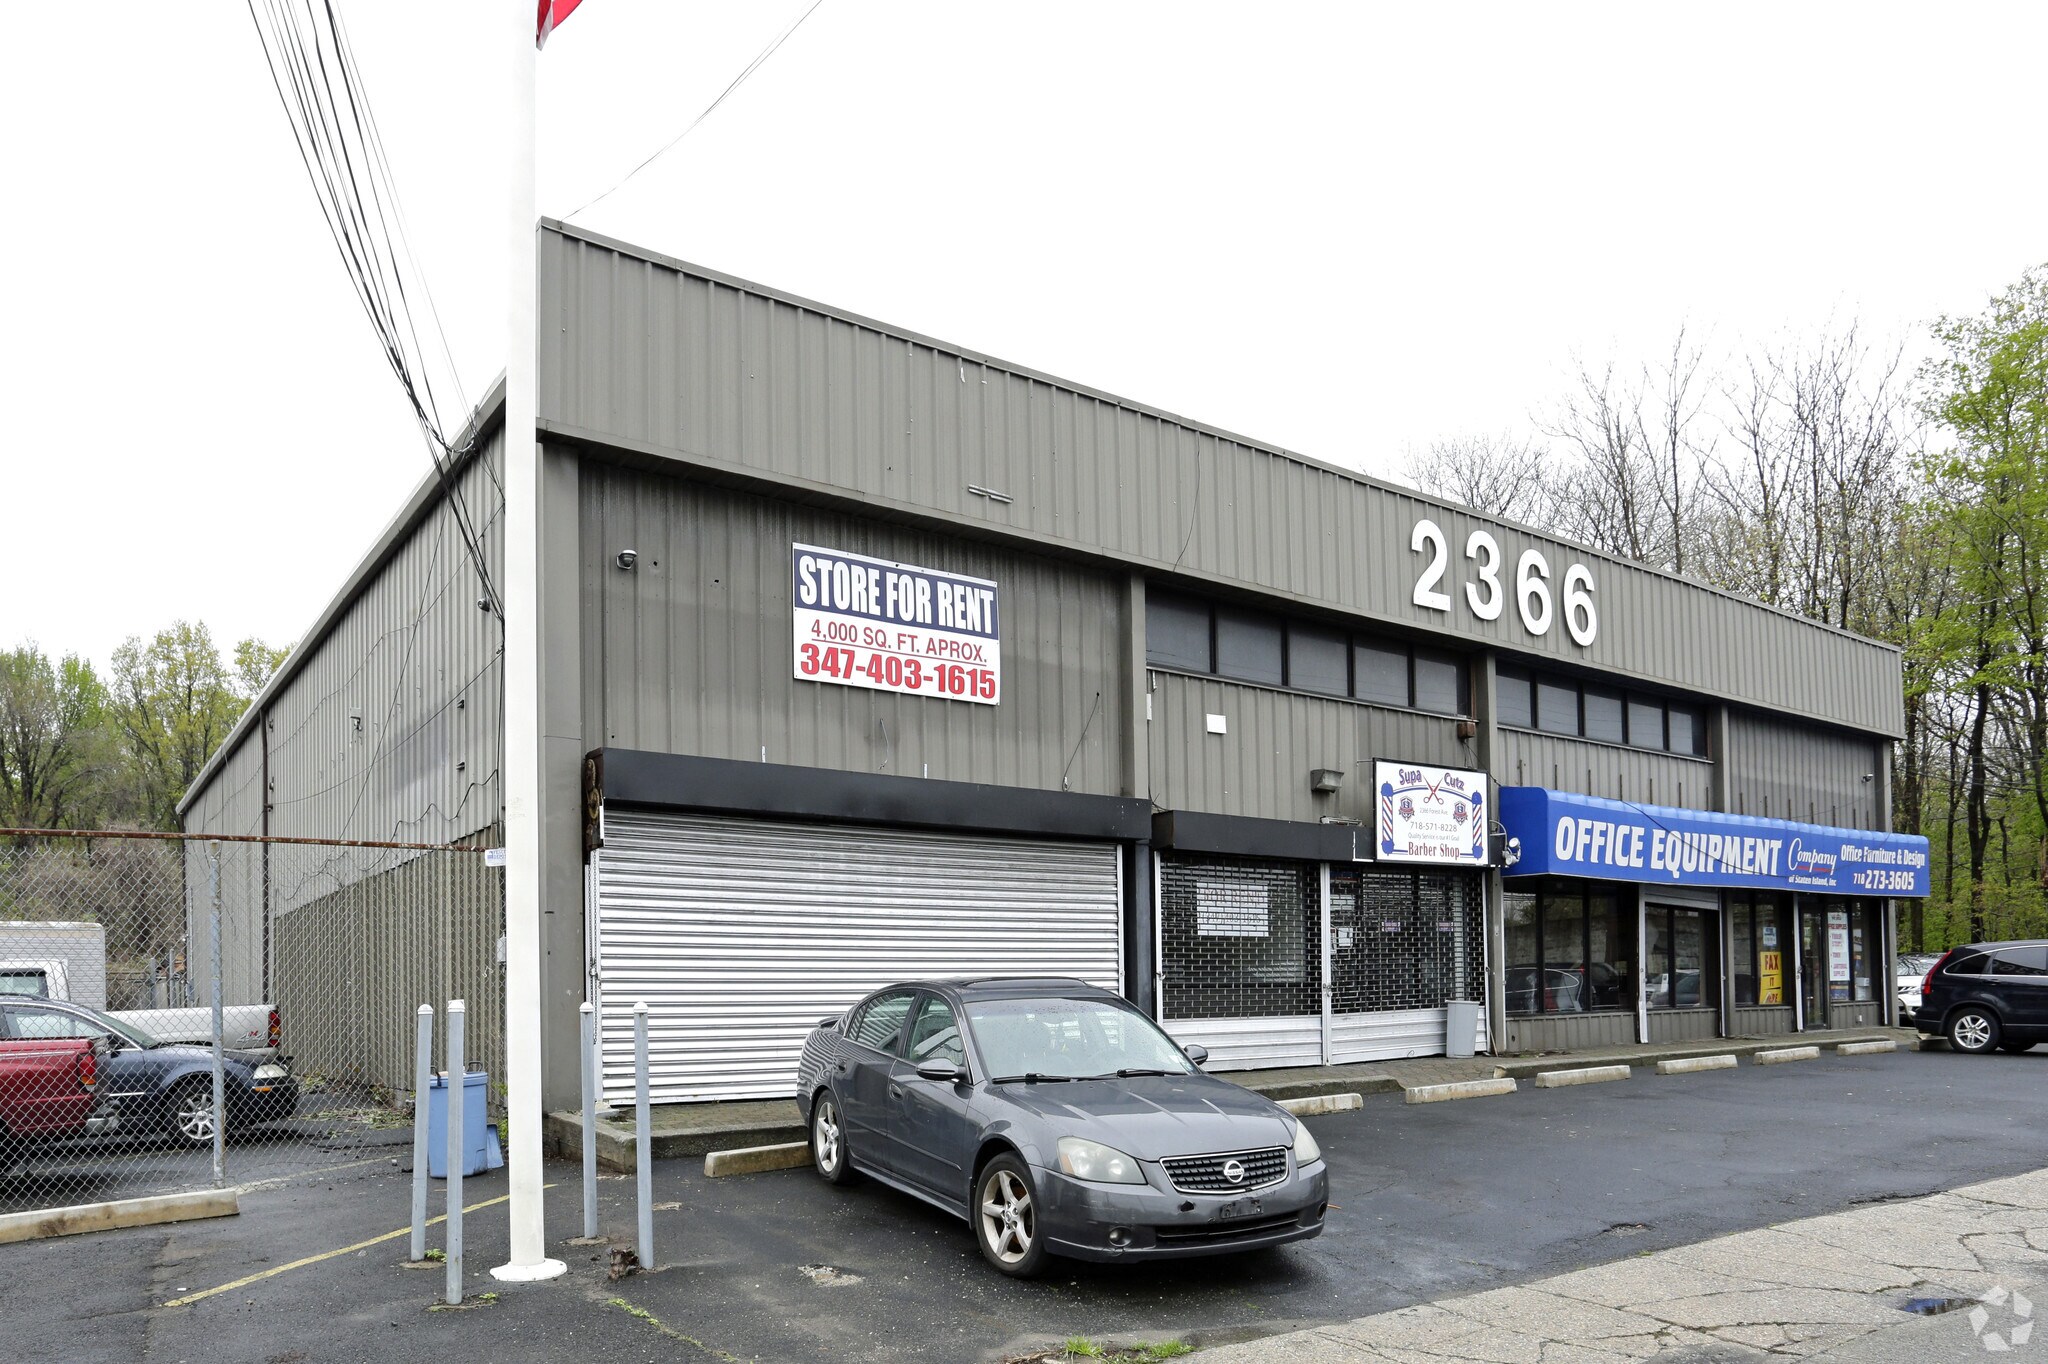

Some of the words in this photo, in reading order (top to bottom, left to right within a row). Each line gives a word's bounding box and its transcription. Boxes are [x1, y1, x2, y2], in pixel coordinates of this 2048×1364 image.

[799, 555, 881, 616] STORE
[886, 571, 932, 624] FOR
[937, 581, 994, 635] RENT
[1411, 519, 1598, 647] 2366
[811, 619, 857, 641] 4,000
[863, 626, 891, 649] SQ.
[897, 633, 920, 653] FT.
[926, 637, 987, 663] APROX.
[800, 643, 996, 699] 347-403-1615
[1398, 768, 1422, 786] Supa
[1443, 772, 1465, 791] Cutz
[1410, 821, 1458, 832] 718-571-8228
[1408, 841, 1437, 857] Barber
[1440, 843, 1460, 860] Shop
[1555, 816, 1645, 868] OFFICE
[1650, 828, 1783, 879] EQUIPMENT
[1788, 837, 1837, 875] Company
[1841, 844, 1862, 862] Office
[1863, 846, 1896, 865] Furniture
[1897, 849, 1902, 865] &
[1903, 850, 1925, 869] Design
[1788, 874, 1795, 883] of
[1795, 874, 1811, 885] Staten
[1853, 873, 1865, 885] 718
[1865, 869, 1914, 891] 273-3605
[1765, 954, 1779, 970] FAX
[1769, 977, 1775, 987] IT
